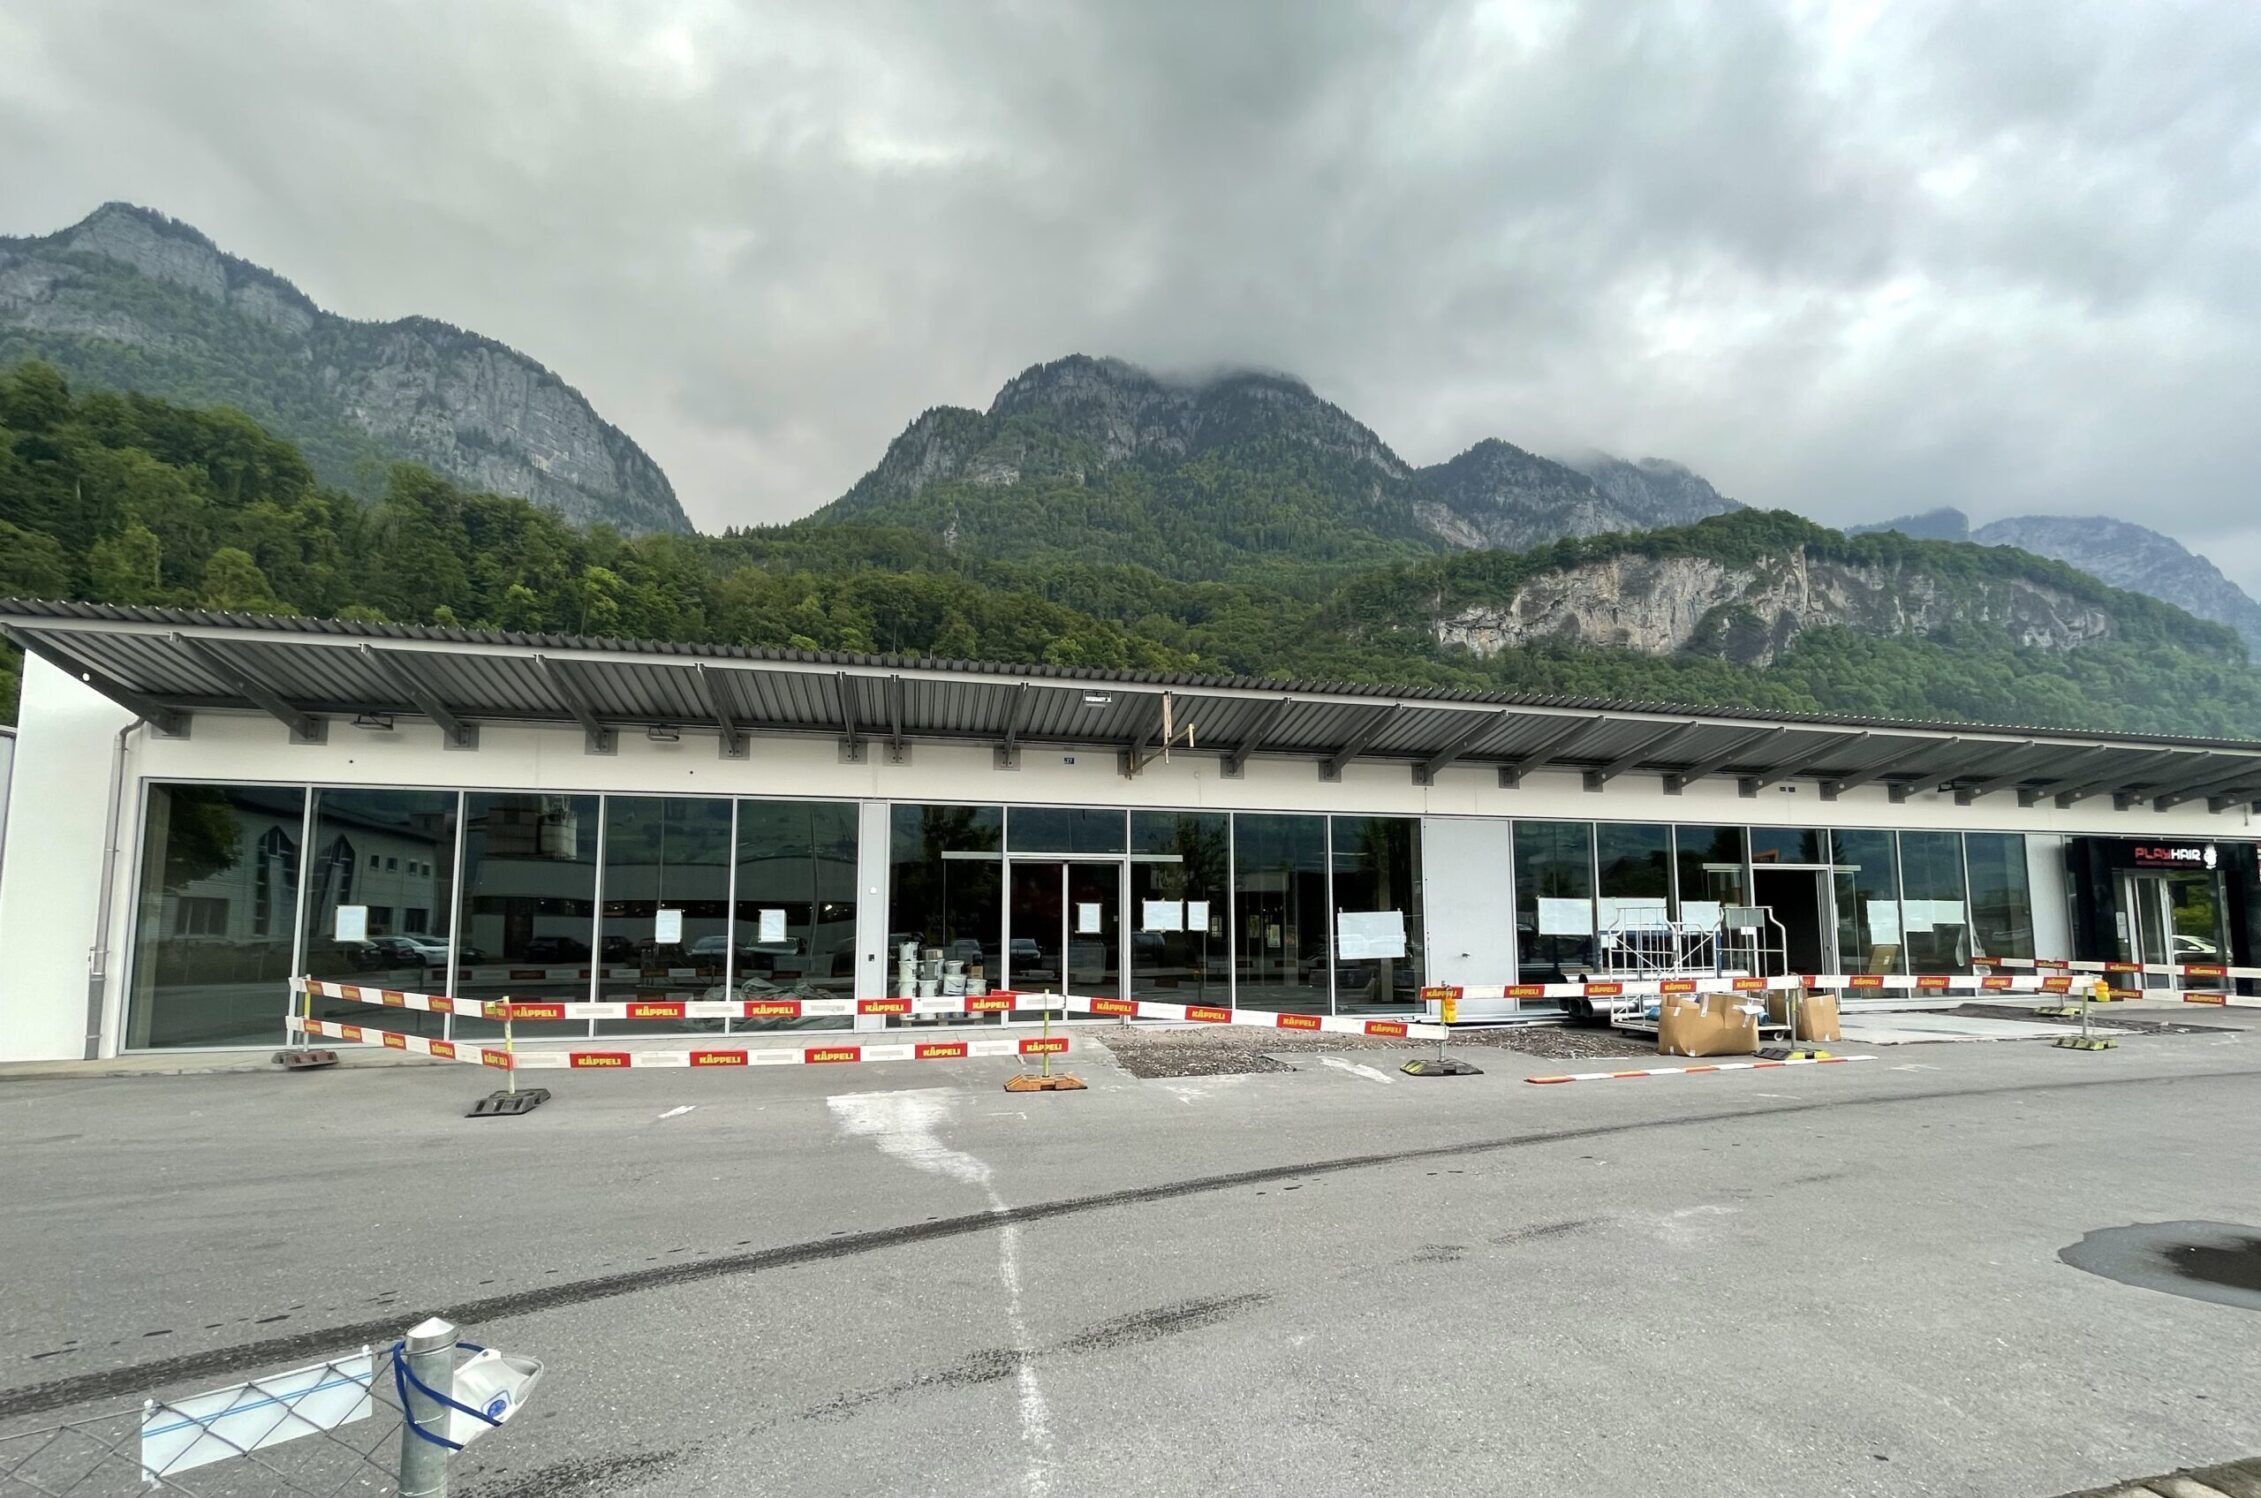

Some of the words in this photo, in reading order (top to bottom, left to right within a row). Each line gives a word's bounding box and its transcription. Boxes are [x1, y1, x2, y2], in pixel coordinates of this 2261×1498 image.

[2134, 847, 2201, 861] PLAYHAIR
[752, 1004, 794, 1015] KÄPPELI
[863, 1003, 905, 1012] KÄPPELI
[973, 999, 1010, 1009] KÄPPELI
[1095, 1001, 1133, 1013] KÄPPELI
[513, 1004, 557, 1017] KÄPPELI
[633, 1005, 679, 1017] KÄPPELI
[1191, 1009, 1226, 1020] KÄPPELI
[1283, 1017, 1316, 1028] KÄPPELI
[1370, 1023, 1404, 1034] KÄPPELI
[923, 1047, 960, 1057] KÄPPELI
[1025, 1041, 1062, 1053] KÄPPELI
[576, 1055, 622, 1066] KÄPPELI
[698, 1053, 742, 1065] KÄPPELI
[812, 1051, 854, 1062] KÄPPELI
